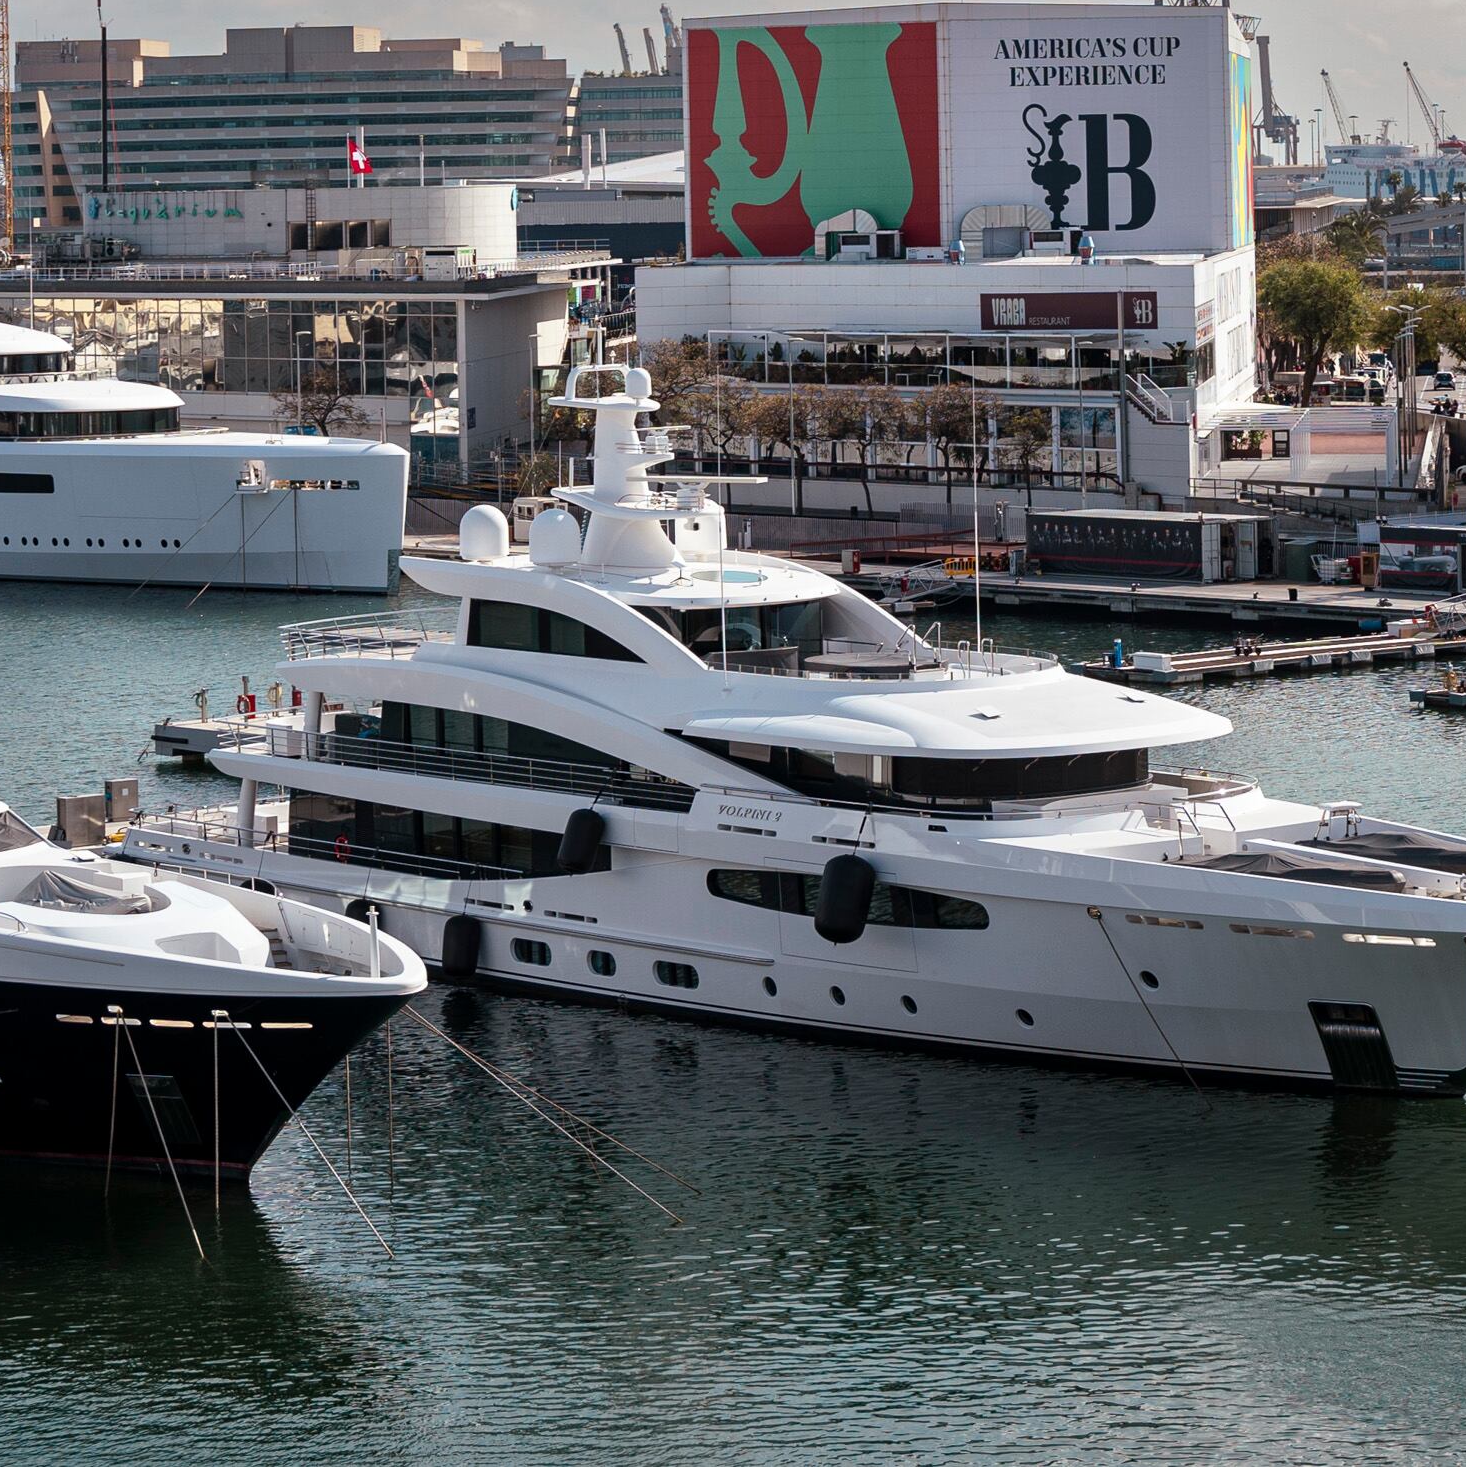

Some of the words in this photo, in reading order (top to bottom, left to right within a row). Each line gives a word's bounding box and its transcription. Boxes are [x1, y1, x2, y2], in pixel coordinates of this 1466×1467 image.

[1133, 36, 1181, 58] CUP
[1009, 64, 1166, 87] EXPERIENCE
[1029, 316, 1071, 326] RESTAURANT
[717, 804, 773, 822] VOLPINI
[773, 811, 783, 823] 2
